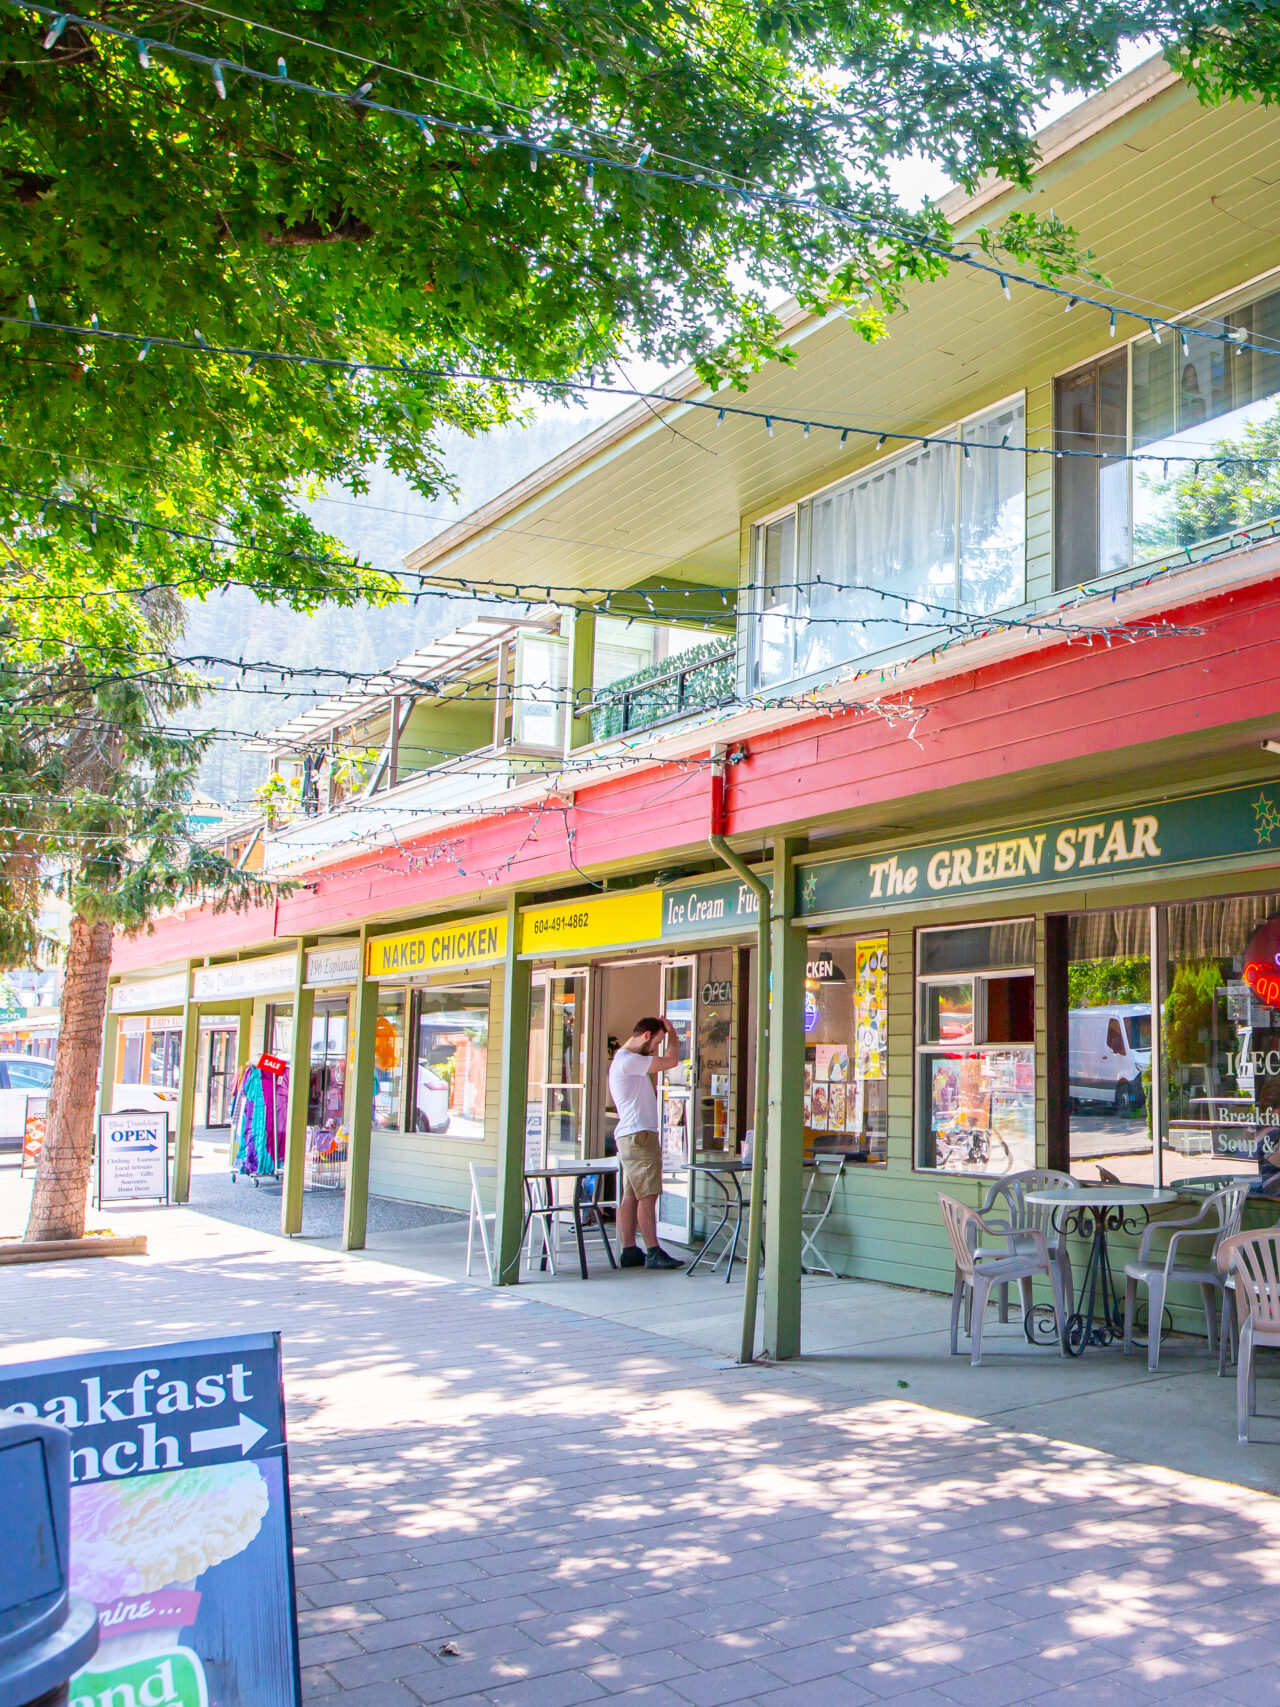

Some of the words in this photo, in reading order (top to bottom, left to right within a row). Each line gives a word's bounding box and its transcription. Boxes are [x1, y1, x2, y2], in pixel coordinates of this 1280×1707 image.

[869, 857, 917, 898] The
[927, 833, 1047, 889] GREEN
[1053, 815, 1162, 872] STAR
[667, 897, 685, 925] Ice
[687, 893, 724, 922] Cream
[735, 885, 774, 915] Fue
[534, 912, 589, 935] 604-491-4862
[383, 940, 426, 969] NAKED
[431, 926, 498, 962] CHICKEN
[310, 958, 323, 977] 196
[806, 960, 833, 978] CKEN
[263, 1059, 281, 1070] SALE
[111, 1129, 158, 1142] OPEN
[1219, 1134, 1258, 1158] Soup
[1262, 1135, 1276, 1154] &
